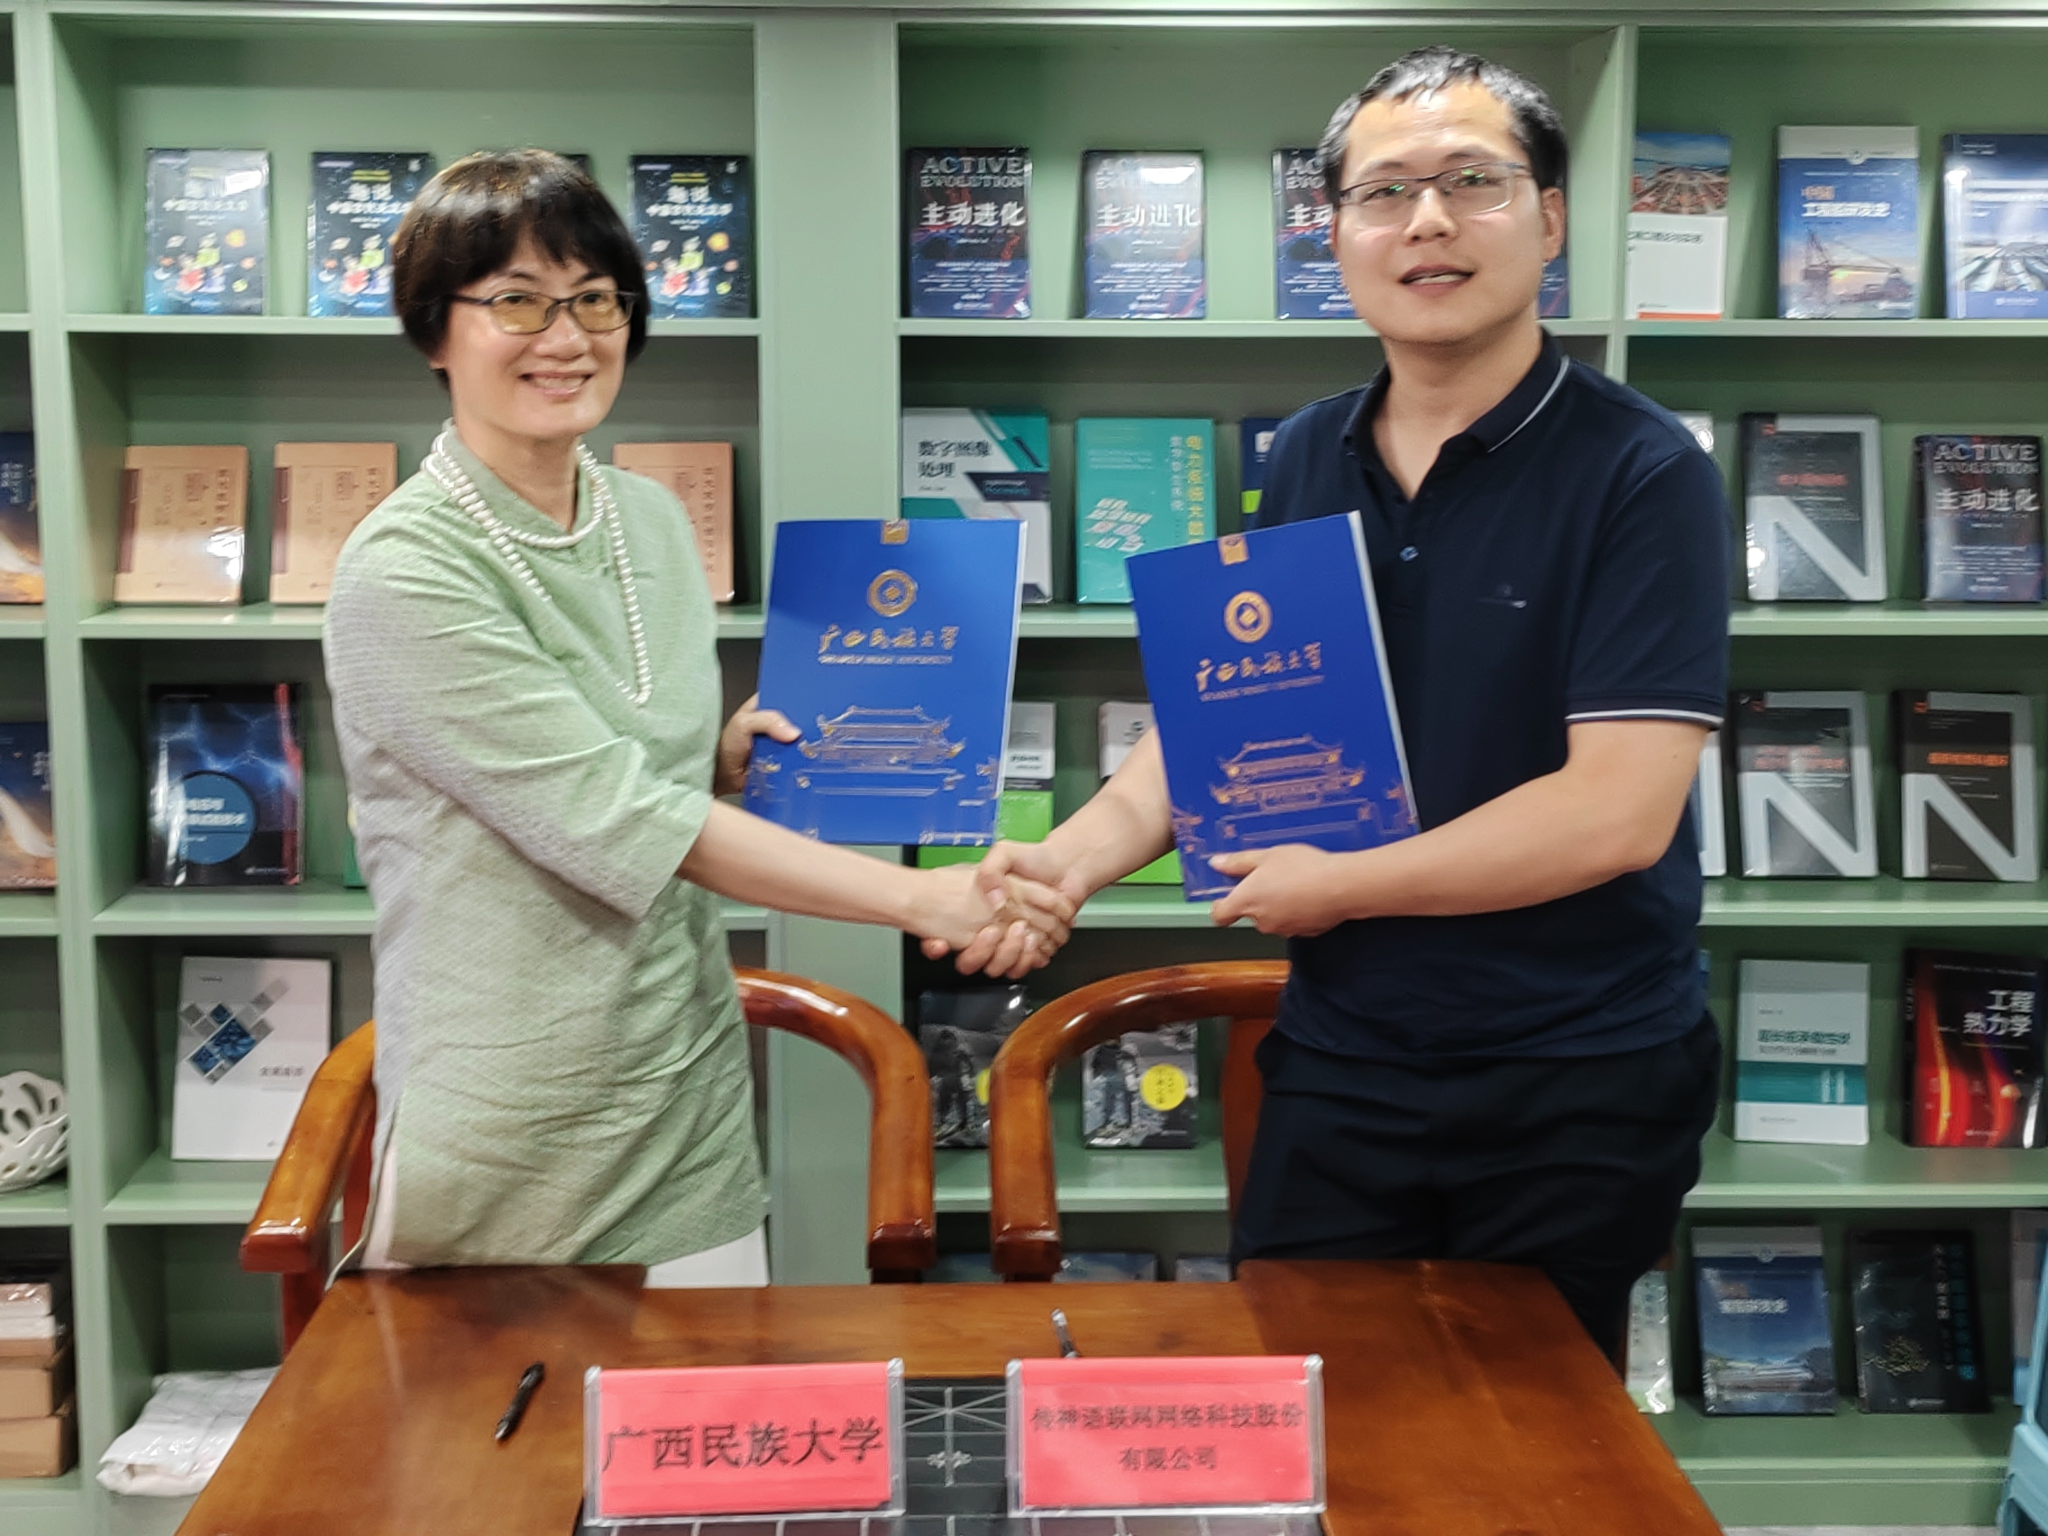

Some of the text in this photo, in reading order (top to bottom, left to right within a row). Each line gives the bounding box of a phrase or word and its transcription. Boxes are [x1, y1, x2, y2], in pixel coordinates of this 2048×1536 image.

[920, 156, 1025, 174] ACTIVE
[919, 201, 1028, 228] 主动进化
[1096, 202, 1202, 228] 主动进化
[1285, 202, 1335, 228] 主动
[918, 439, 991, 458] 数字图像
[1933, 443, 2040, 461] ACTIVE
[918, 461, 956, 479] 处理
[1935, 487, 2041, 512] 主动进化
[817, 622, 961, 655] 广西民族大学
[1195, 641, 1321, 694] 广西民族大学
[1985, 988, 2036, 1013] 工程
[1962, 1011, 2033, 1038] 热力学
[601, 1415, 886, 1474] 广西民族大学
[1118, 1445, 1219, 1474] 有限公司
